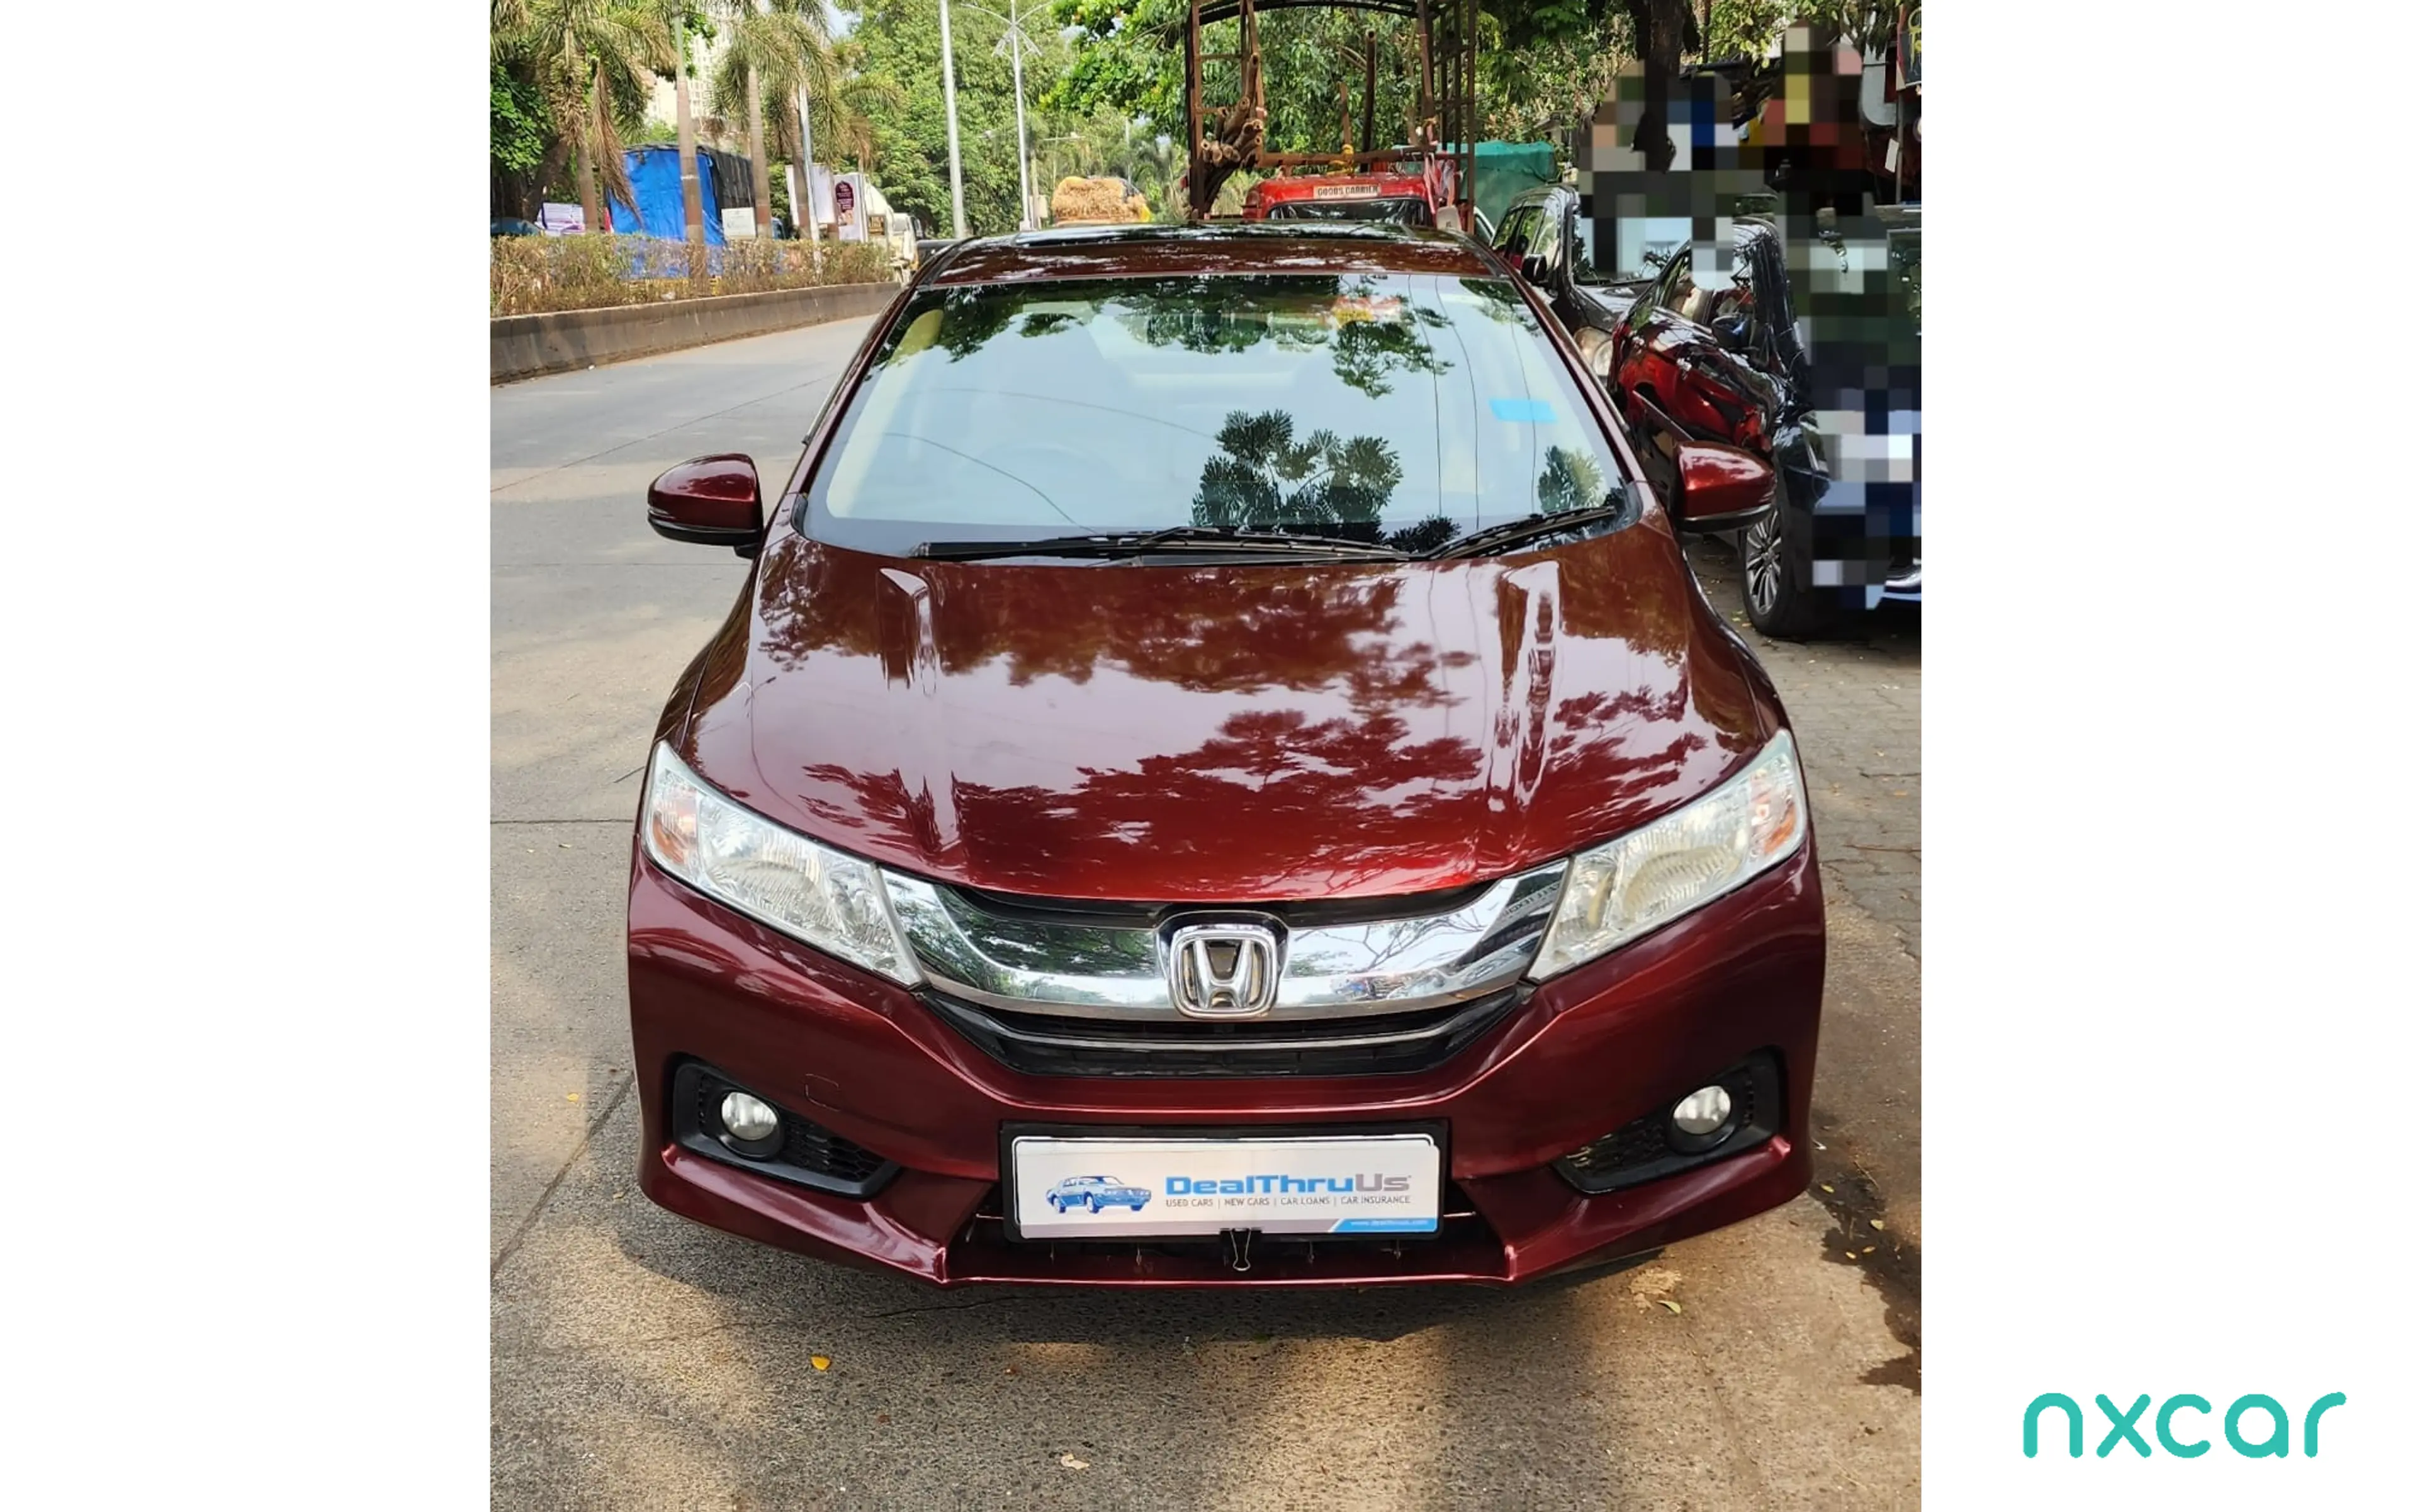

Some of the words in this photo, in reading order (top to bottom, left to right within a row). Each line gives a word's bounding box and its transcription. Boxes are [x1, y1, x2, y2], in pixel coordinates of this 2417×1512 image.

[1166, 1173, 1410, 1195] DealThruUs
[1166, 1199, 1189, 1207] USED
[1191, 1199, 1214, 1207] CARS
[1224, 1198, 1244, 1206] NEW
[1247, 1198, 1270, 1206] CARS
[1341, 1197, 1358, 1205] CAR
[1361, 1196, 1411, 1204] INSURANCE
